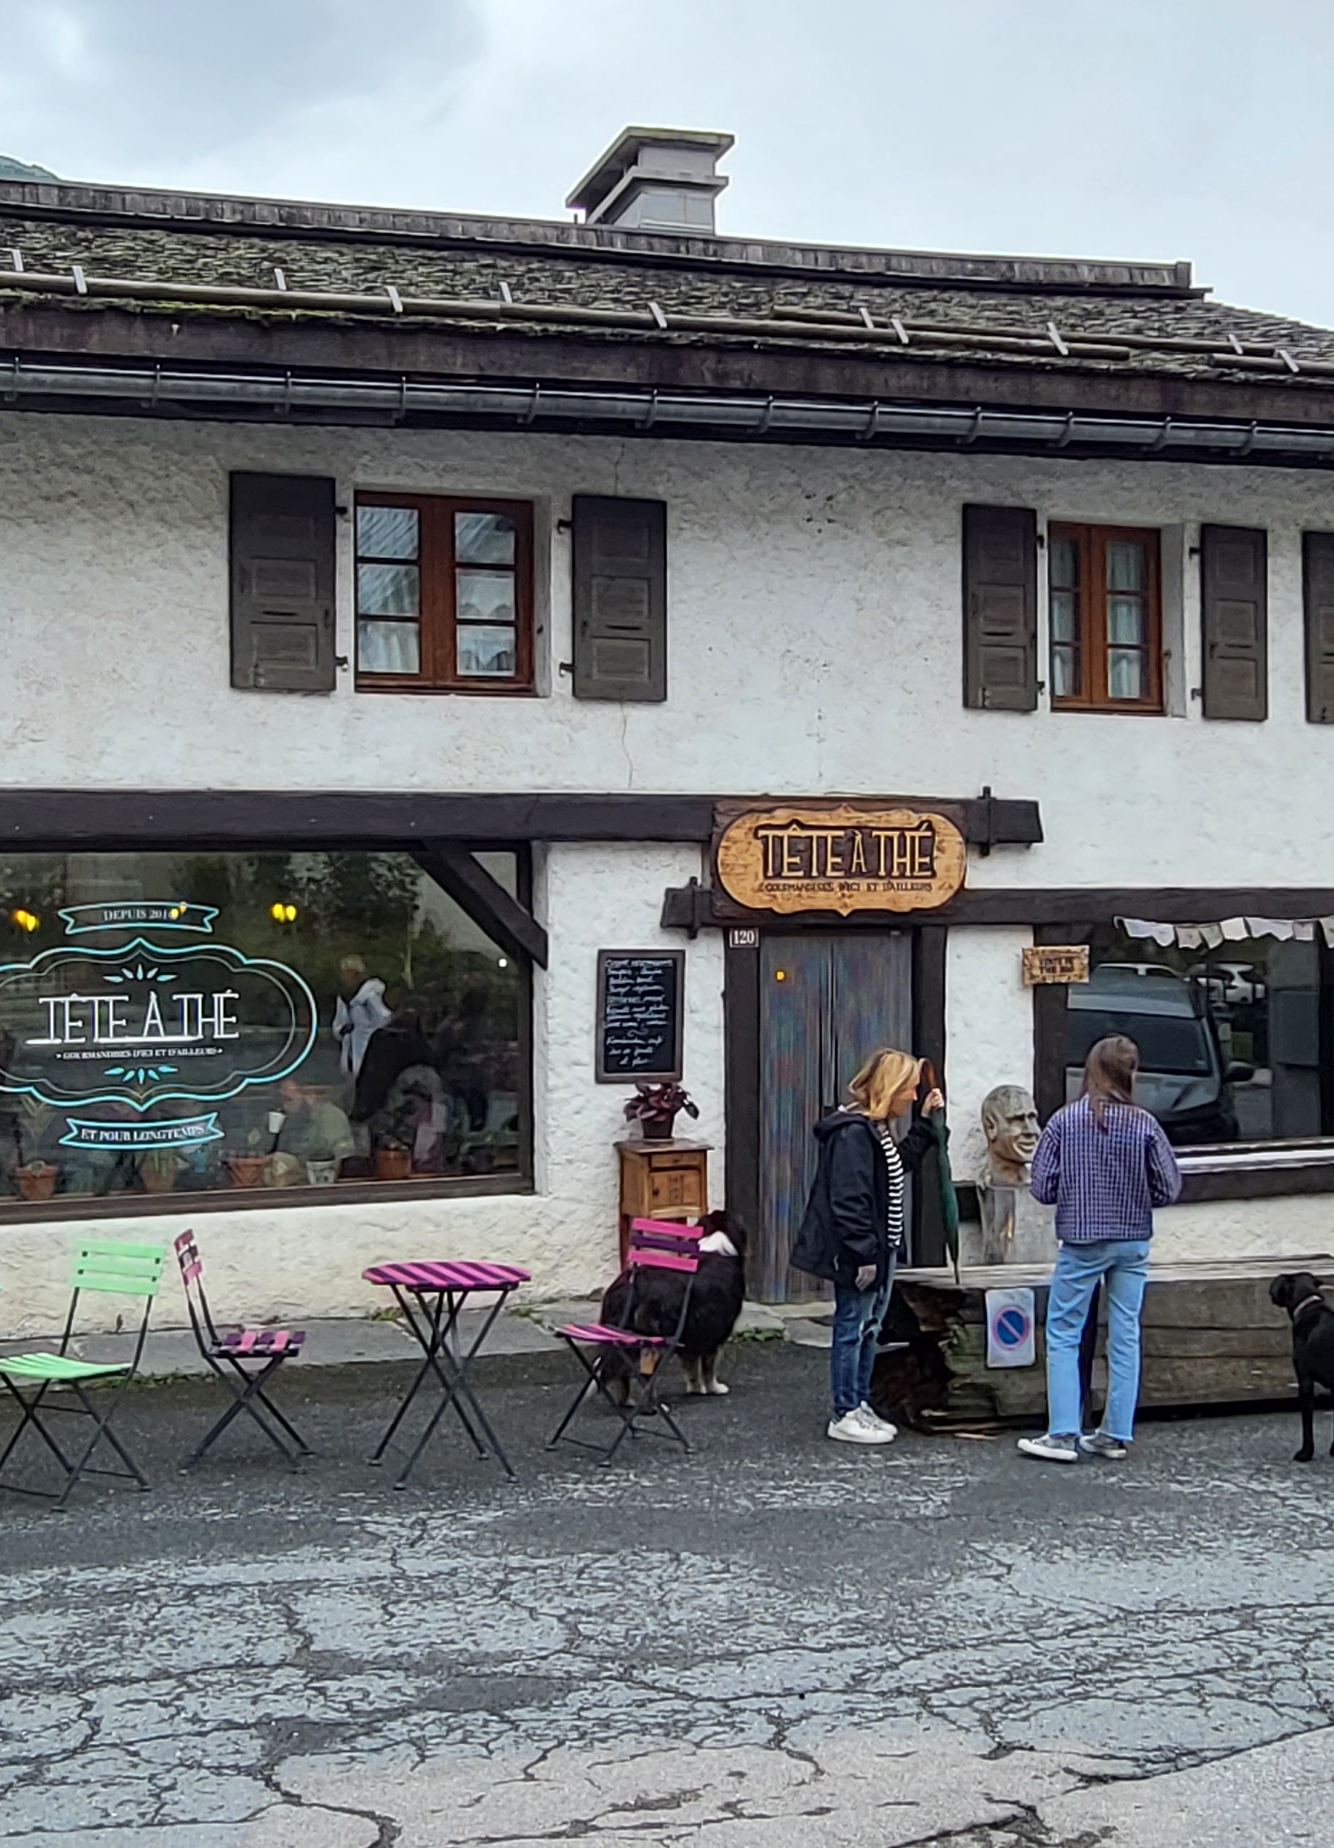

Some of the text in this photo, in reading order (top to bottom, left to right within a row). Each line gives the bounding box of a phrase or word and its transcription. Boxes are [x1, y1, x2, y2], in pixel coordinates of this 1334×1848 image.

[757, 822, 933, 877] TÊTE À THÉ
[866, 882, 880, 892] ET
[103, 907, 147, 921] DEPUIS
[734, 930, 755, 945] 120
[26, 989, 240, 1044] TÊTE À THÉ
[155, 1048, 166, 1057] ET
[81, 1125, 206, 1142] ET POUR LONGTEMPS
